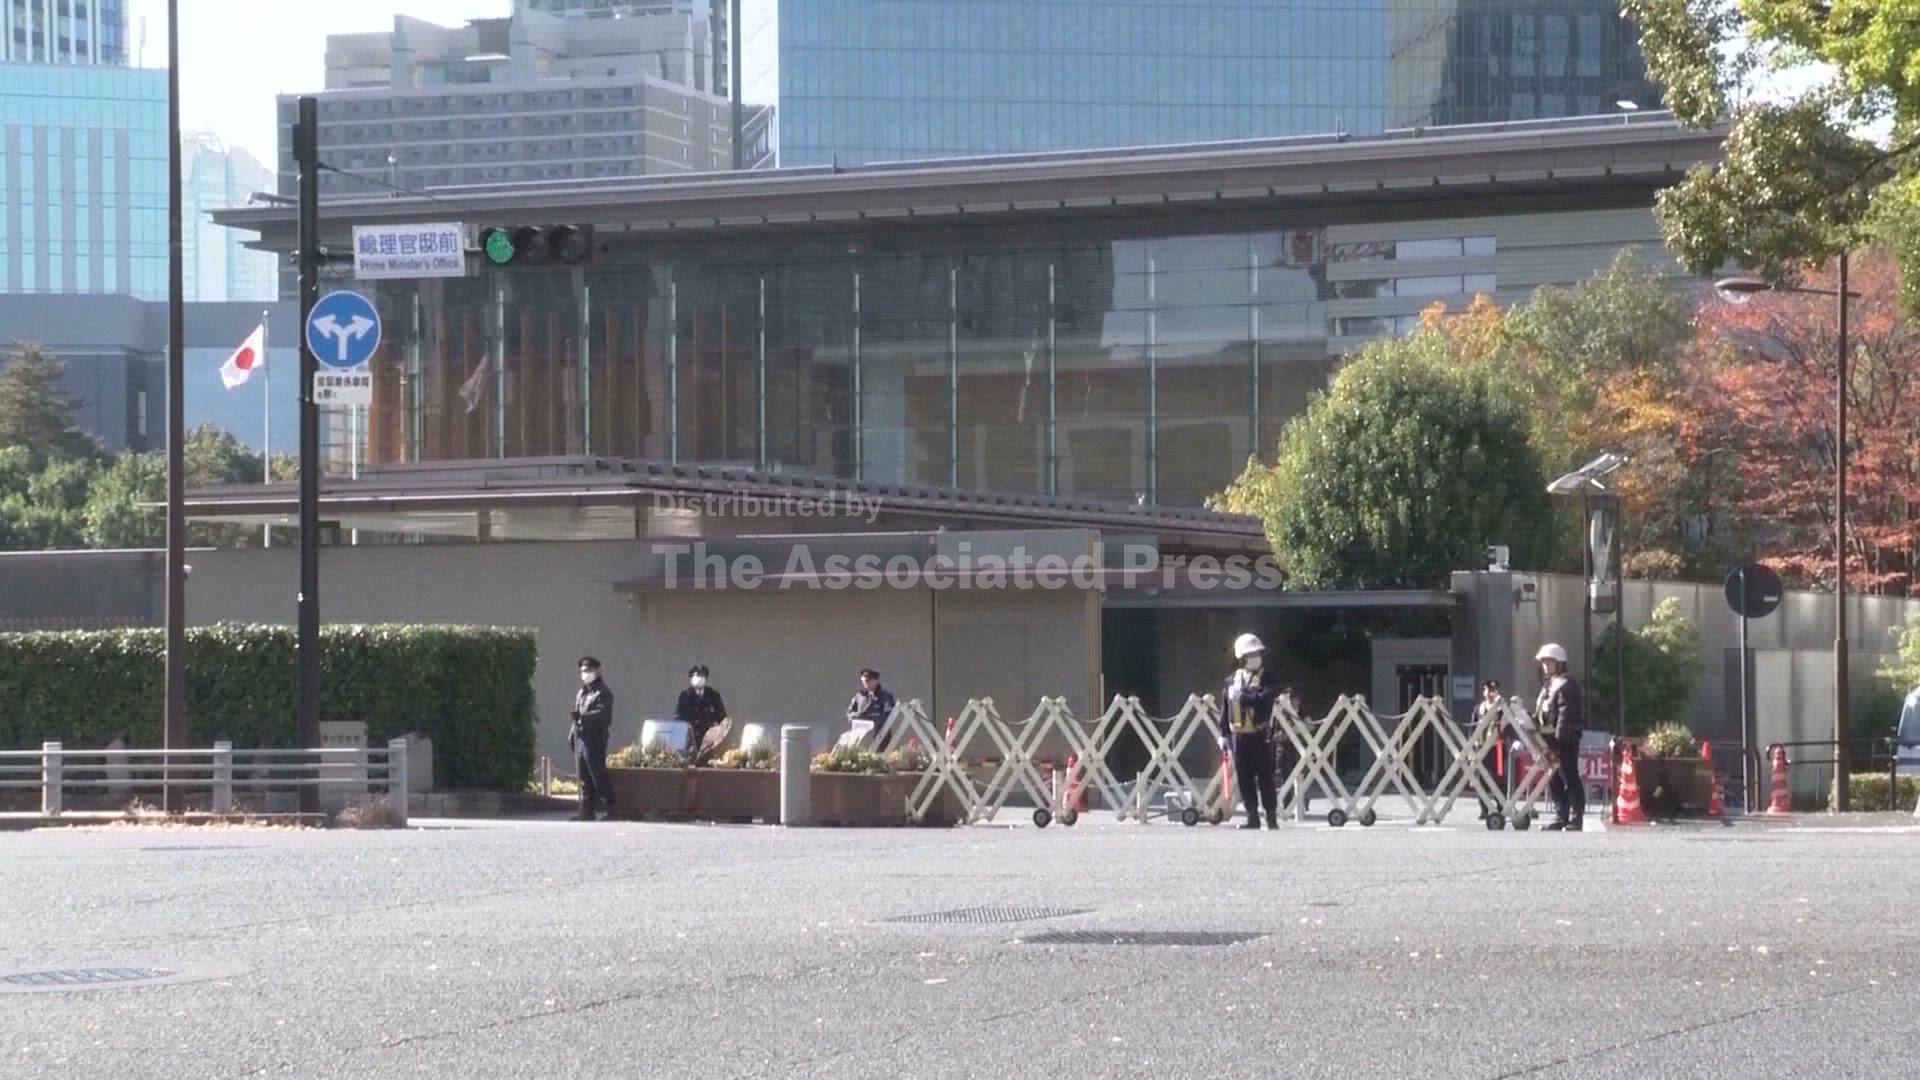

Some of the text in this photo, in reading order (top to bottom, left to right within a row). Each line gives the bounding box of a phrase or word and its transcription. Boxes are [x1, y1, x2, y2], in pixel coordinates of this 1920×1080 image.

[360, 257, 459, 271] Prime Minister's Office
